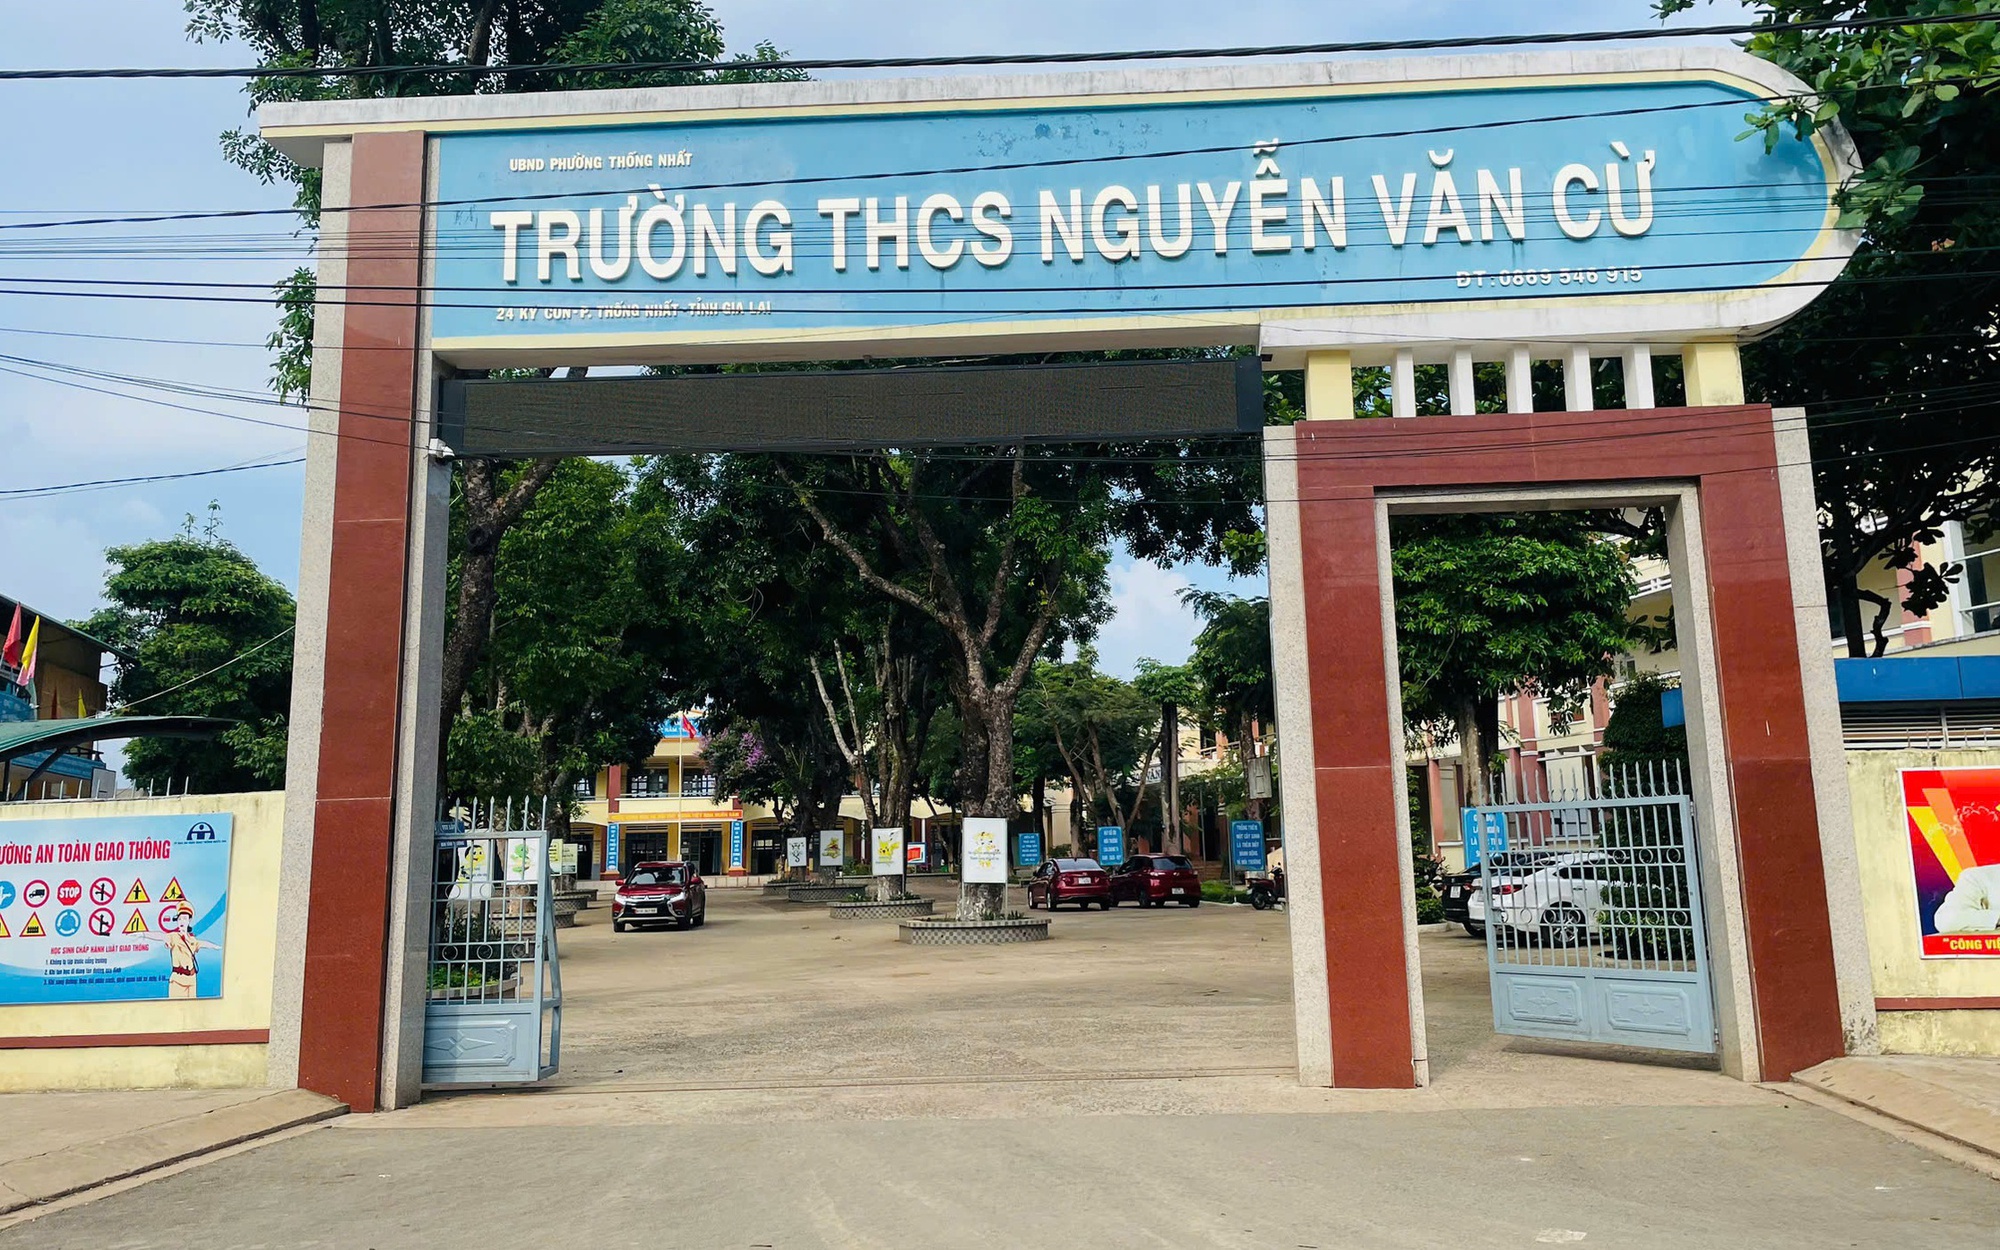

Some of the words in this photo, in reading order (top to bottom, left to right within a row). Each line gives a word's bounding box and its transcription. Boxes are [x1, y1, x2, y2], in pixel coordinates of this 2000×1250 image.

[510, 158, 545, 172] UBND
[550, 152, 602, 171] PHƯỜNG
[609, 151, 653, 168] THỐNG
[658, 149, 693, 167] NHẤT
[490, 183, 793, 284] TRƯỜNG
[817, 191, 1013, 273] THCS
[1039, 138, 1347, 264] NGUYỄN
[1371, 148, 1526, 249] VĂN
[1552, 141, 1656, 240] CỪ
[1559, 266, 1598, 285] 546
[1606, 265, 1643, 283] 915
[496, 307, 514, 321] 24
[597, 300, 640, 318] THỐNG
[722, 300, 745, 316] GIA
[749, 300, 772, 316] LAI
[35, 845, 55, 864] AN
[57, 839, 90, 863] TOÀN
[94, 842, 125, 862] GIAO
[129, 837, 171, 861] THÔNG
[59, 886, 79, 899] STOP
